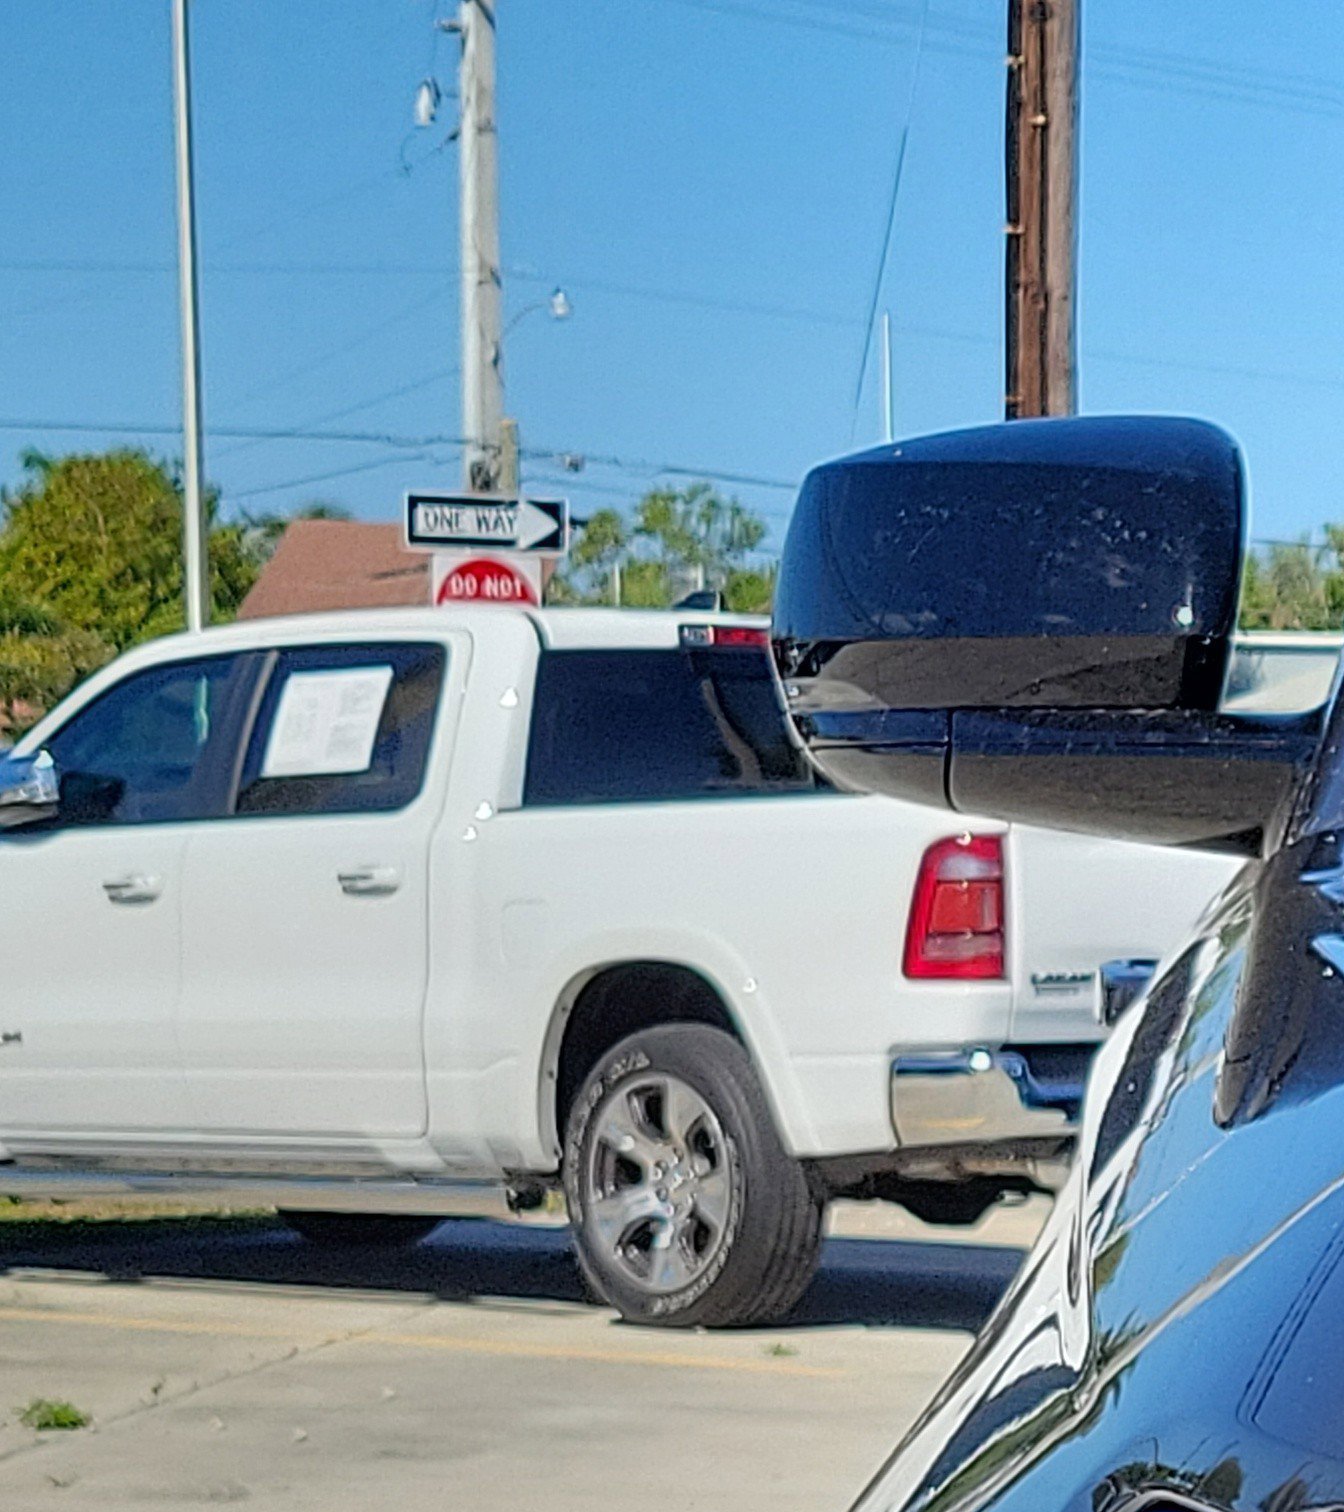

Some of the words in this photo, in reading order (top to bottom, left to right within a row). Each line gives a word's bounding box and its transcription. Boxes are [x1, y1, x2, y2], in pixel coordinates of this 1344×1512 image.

[423, 505, 463, 533] ONE
[474, 506, 518, 534] WAY
[450, 571, 479, 598] DO
[484, 572, 523, 599] NOT
